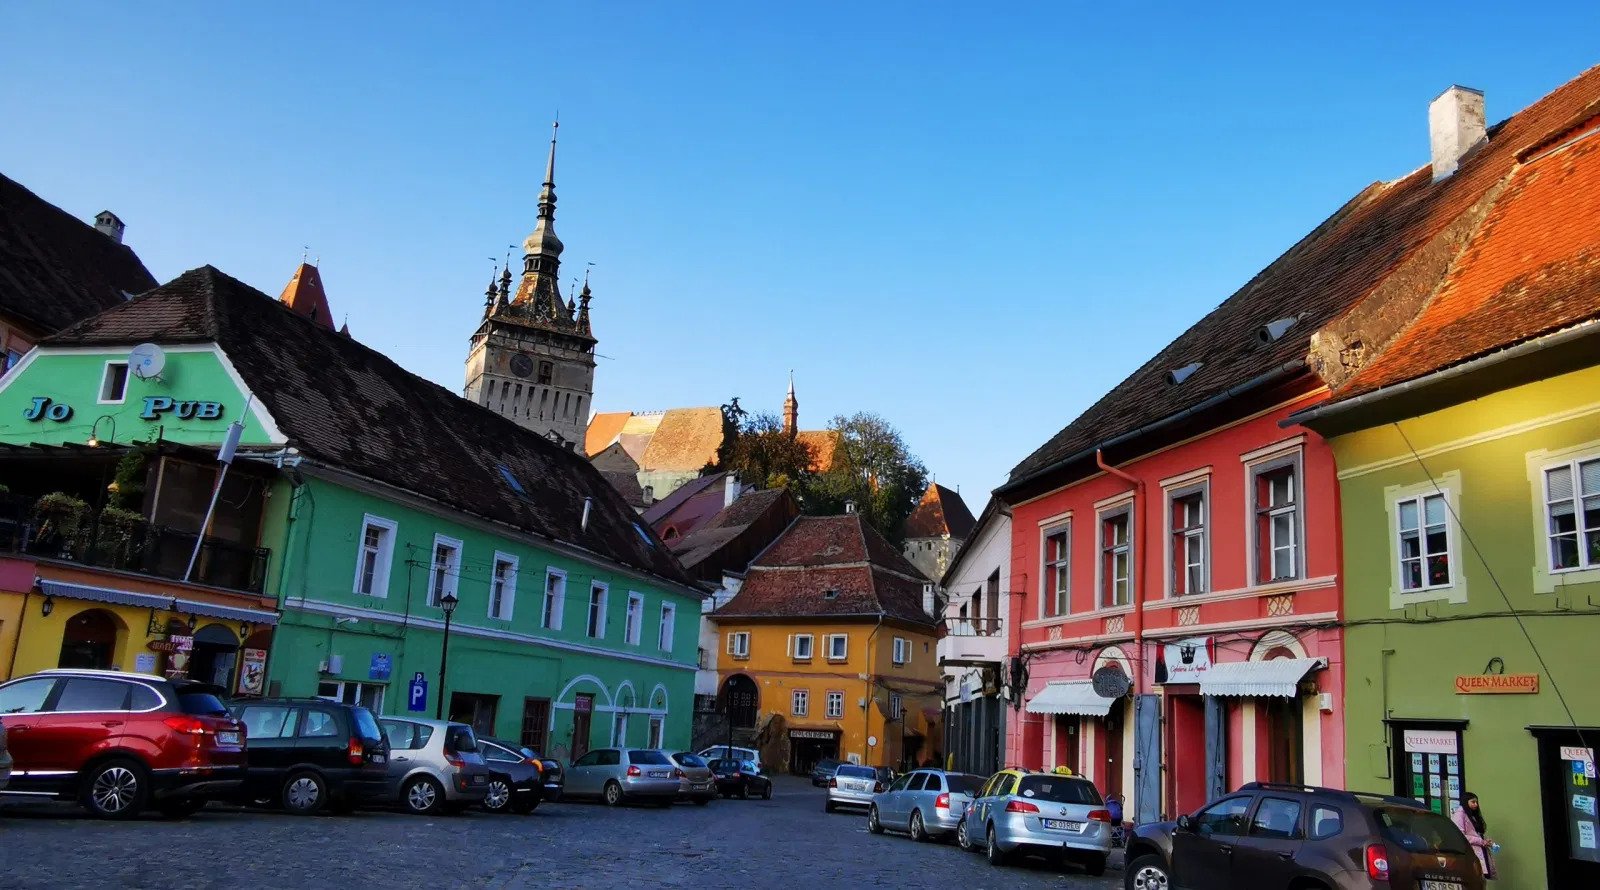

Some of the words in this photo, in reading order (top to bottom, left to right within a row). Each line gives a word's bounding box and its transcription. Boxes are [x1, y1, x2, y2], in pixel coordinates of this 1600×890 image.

[1456, 676, 1489, 692] QUEEN
[1491, 675, 1535, 687] MARKET
[412, 685, 424, 705] P
[1405, 736, 1428, 748] QUEEN
[1430, 737, 1456, 746] MARKET
